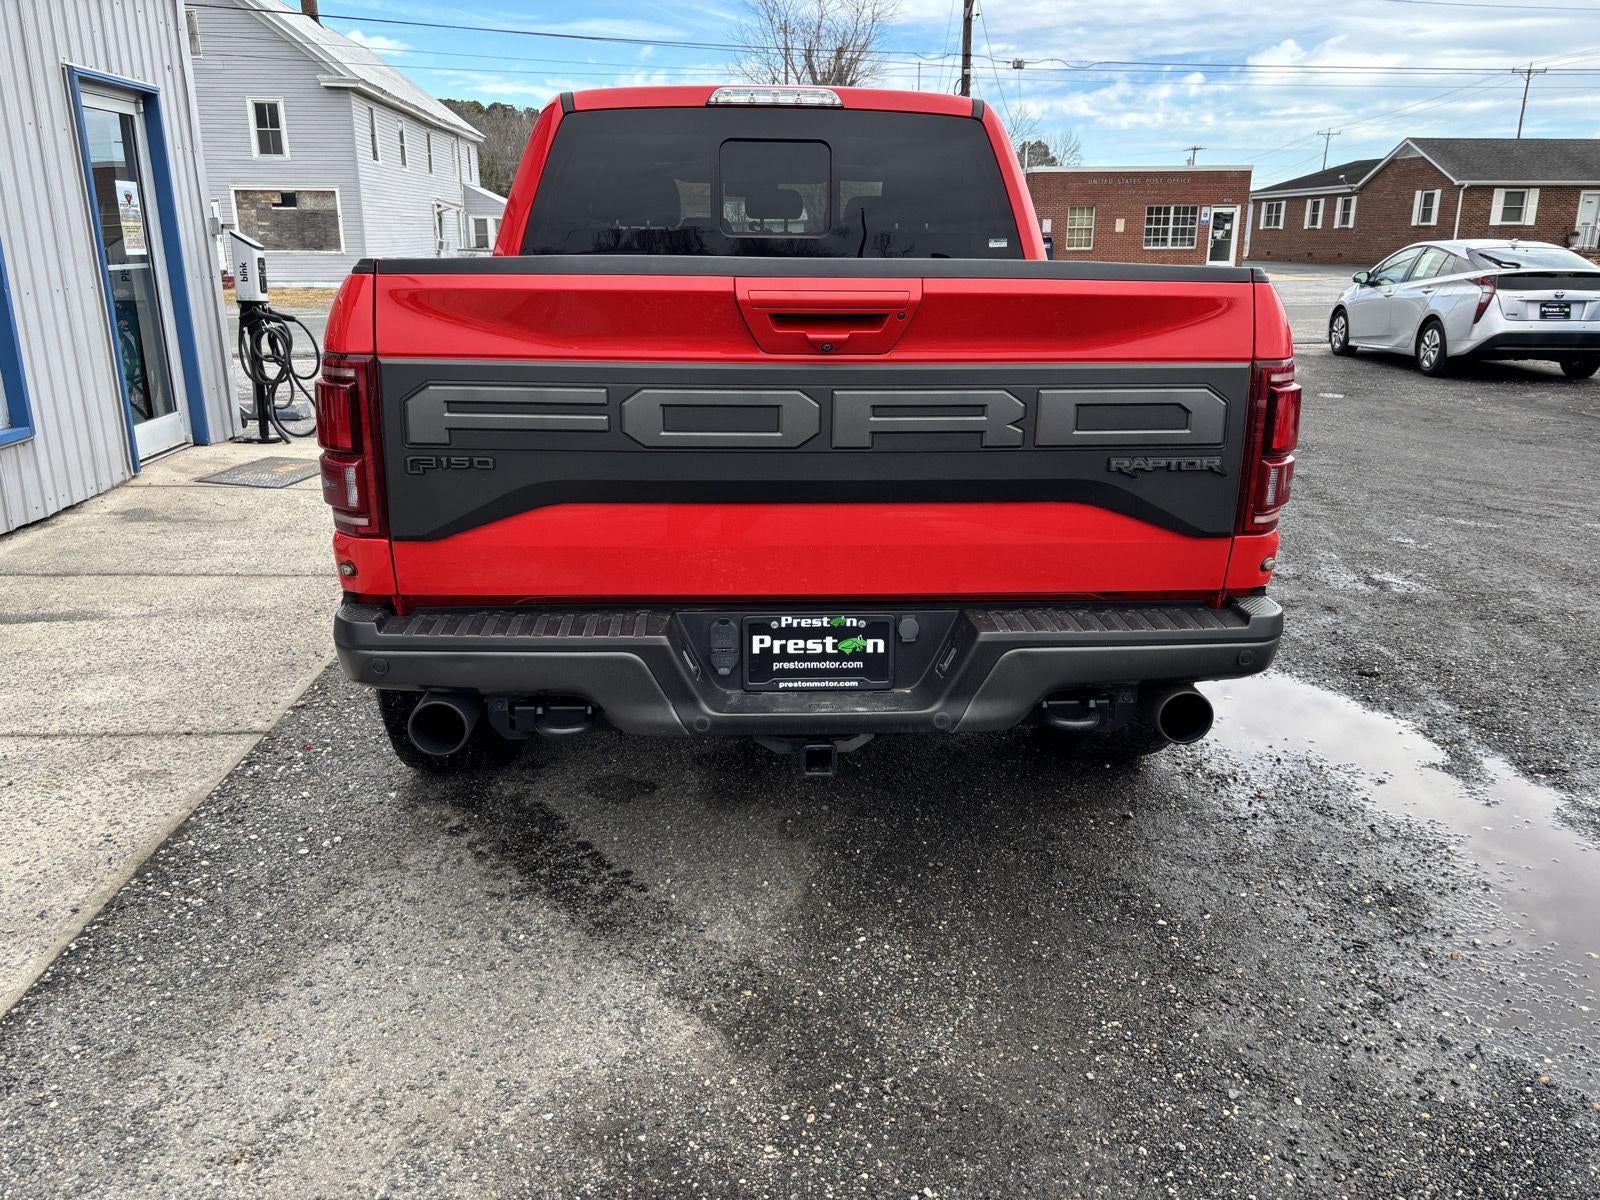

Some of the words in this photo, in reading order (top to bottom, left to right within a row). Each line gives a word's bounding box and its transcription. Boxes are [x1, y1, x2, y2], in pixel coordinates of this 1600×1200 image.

[240, 261, 248, 282] blink
[403, 384, 1228, 449] FORD
[1108, 456, 1227, 477] RAPTOR
[773, 661, 863, 671] prestonmotor.com
[778, 680, 859, 689] prestonmotor.com
